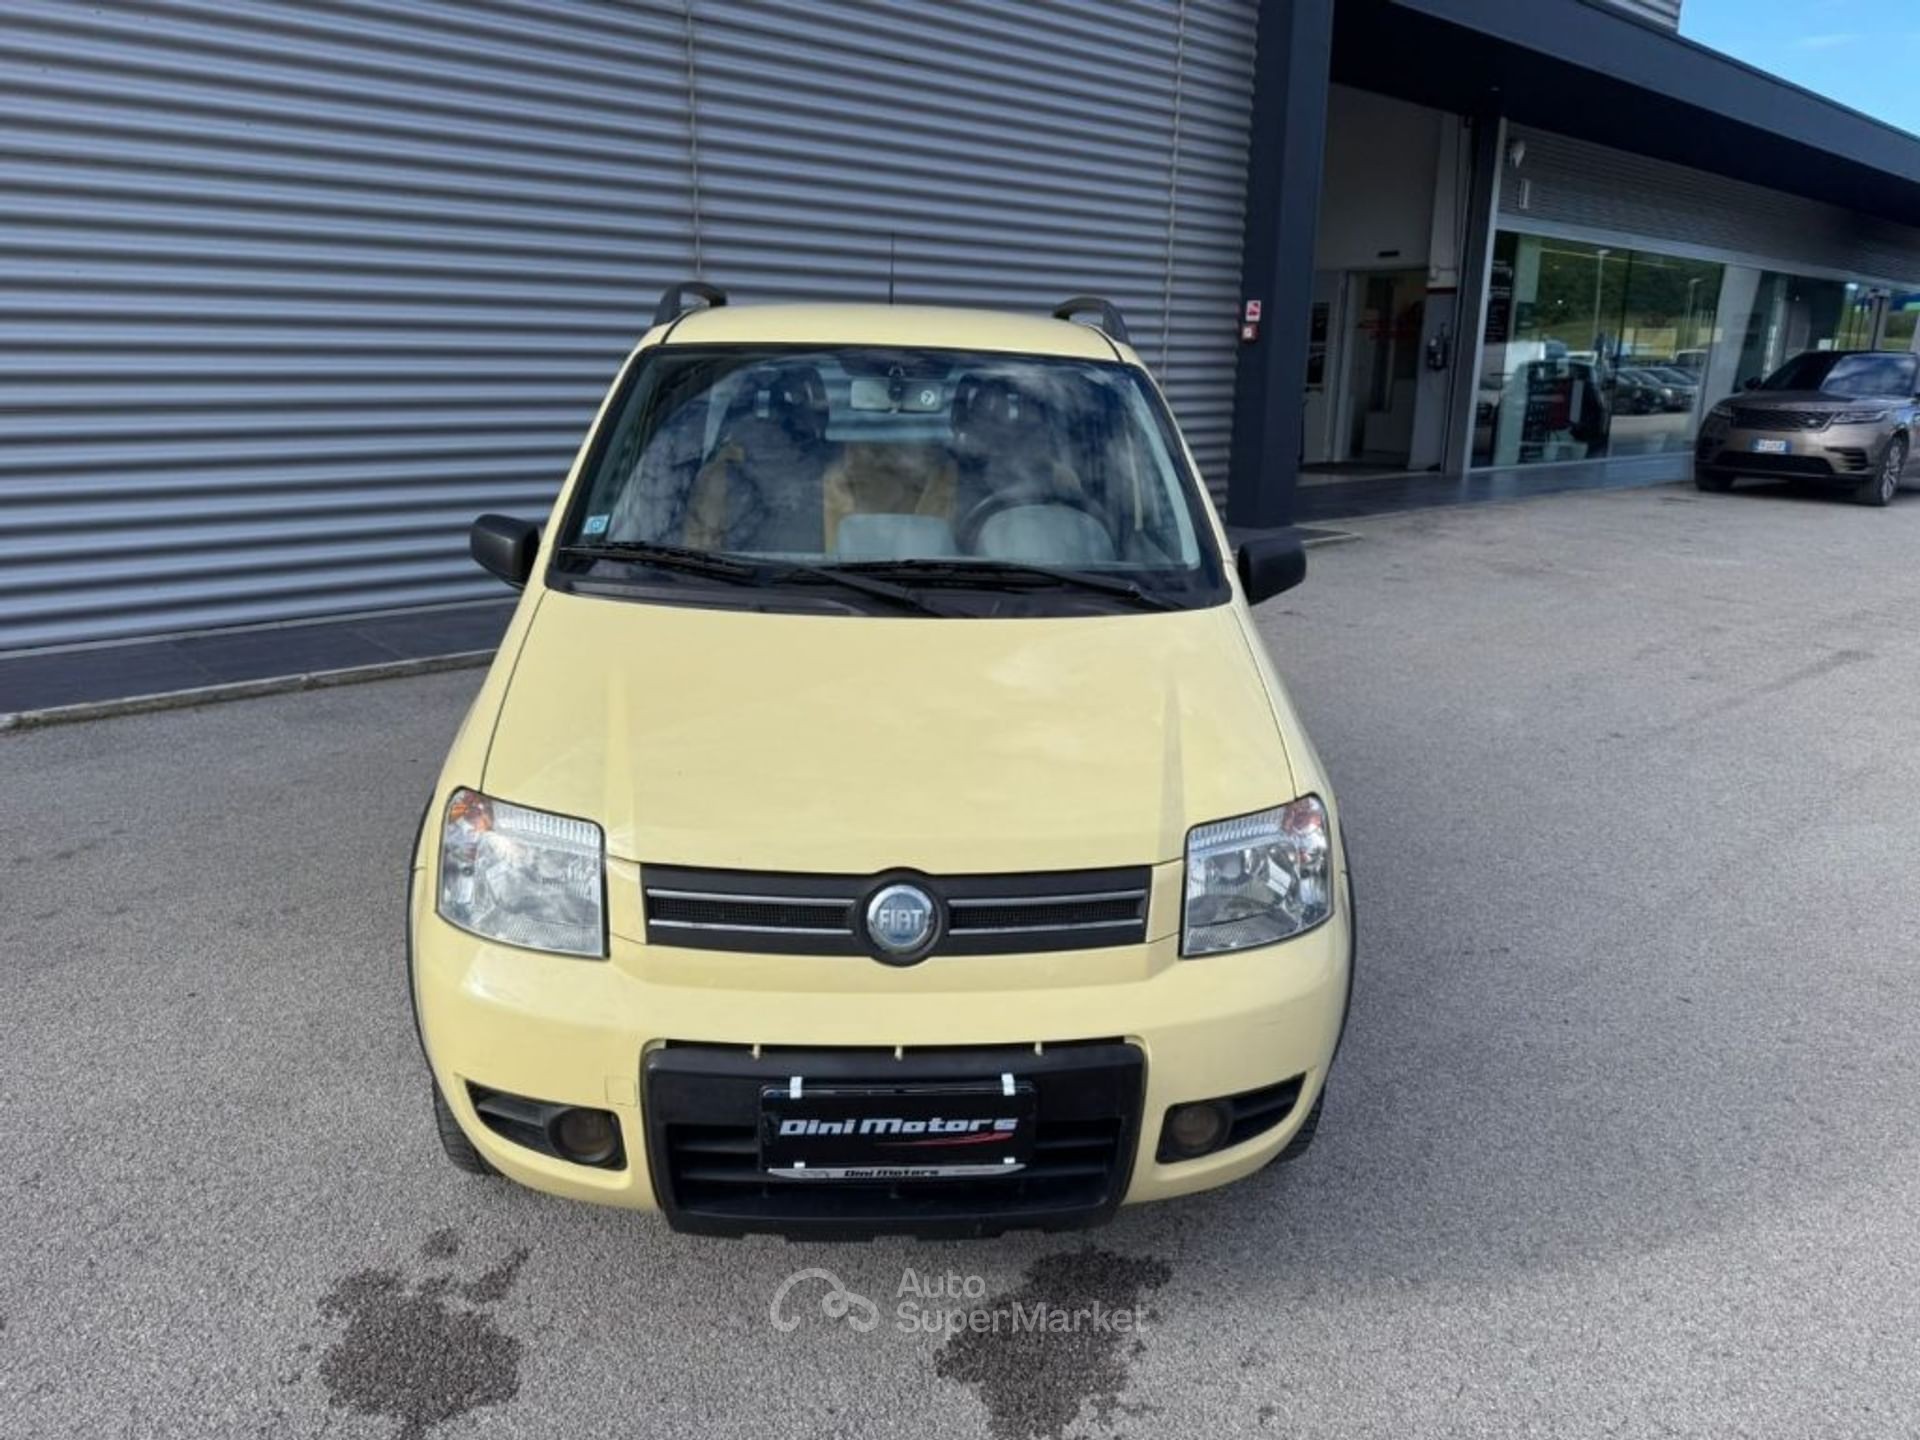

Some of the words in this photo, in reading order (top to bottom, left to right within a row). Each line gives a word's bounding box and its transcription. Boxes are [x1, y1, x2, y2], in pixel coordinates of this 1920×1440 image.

[878, 909, 923, 931] FIAT
[779, 1118, 857, 1136] Dini
[859, 1117, 1019, 1135] Motors
[843, 1169, 874, 1178] Dini
[876, 1168, 940, 1177] Motors
